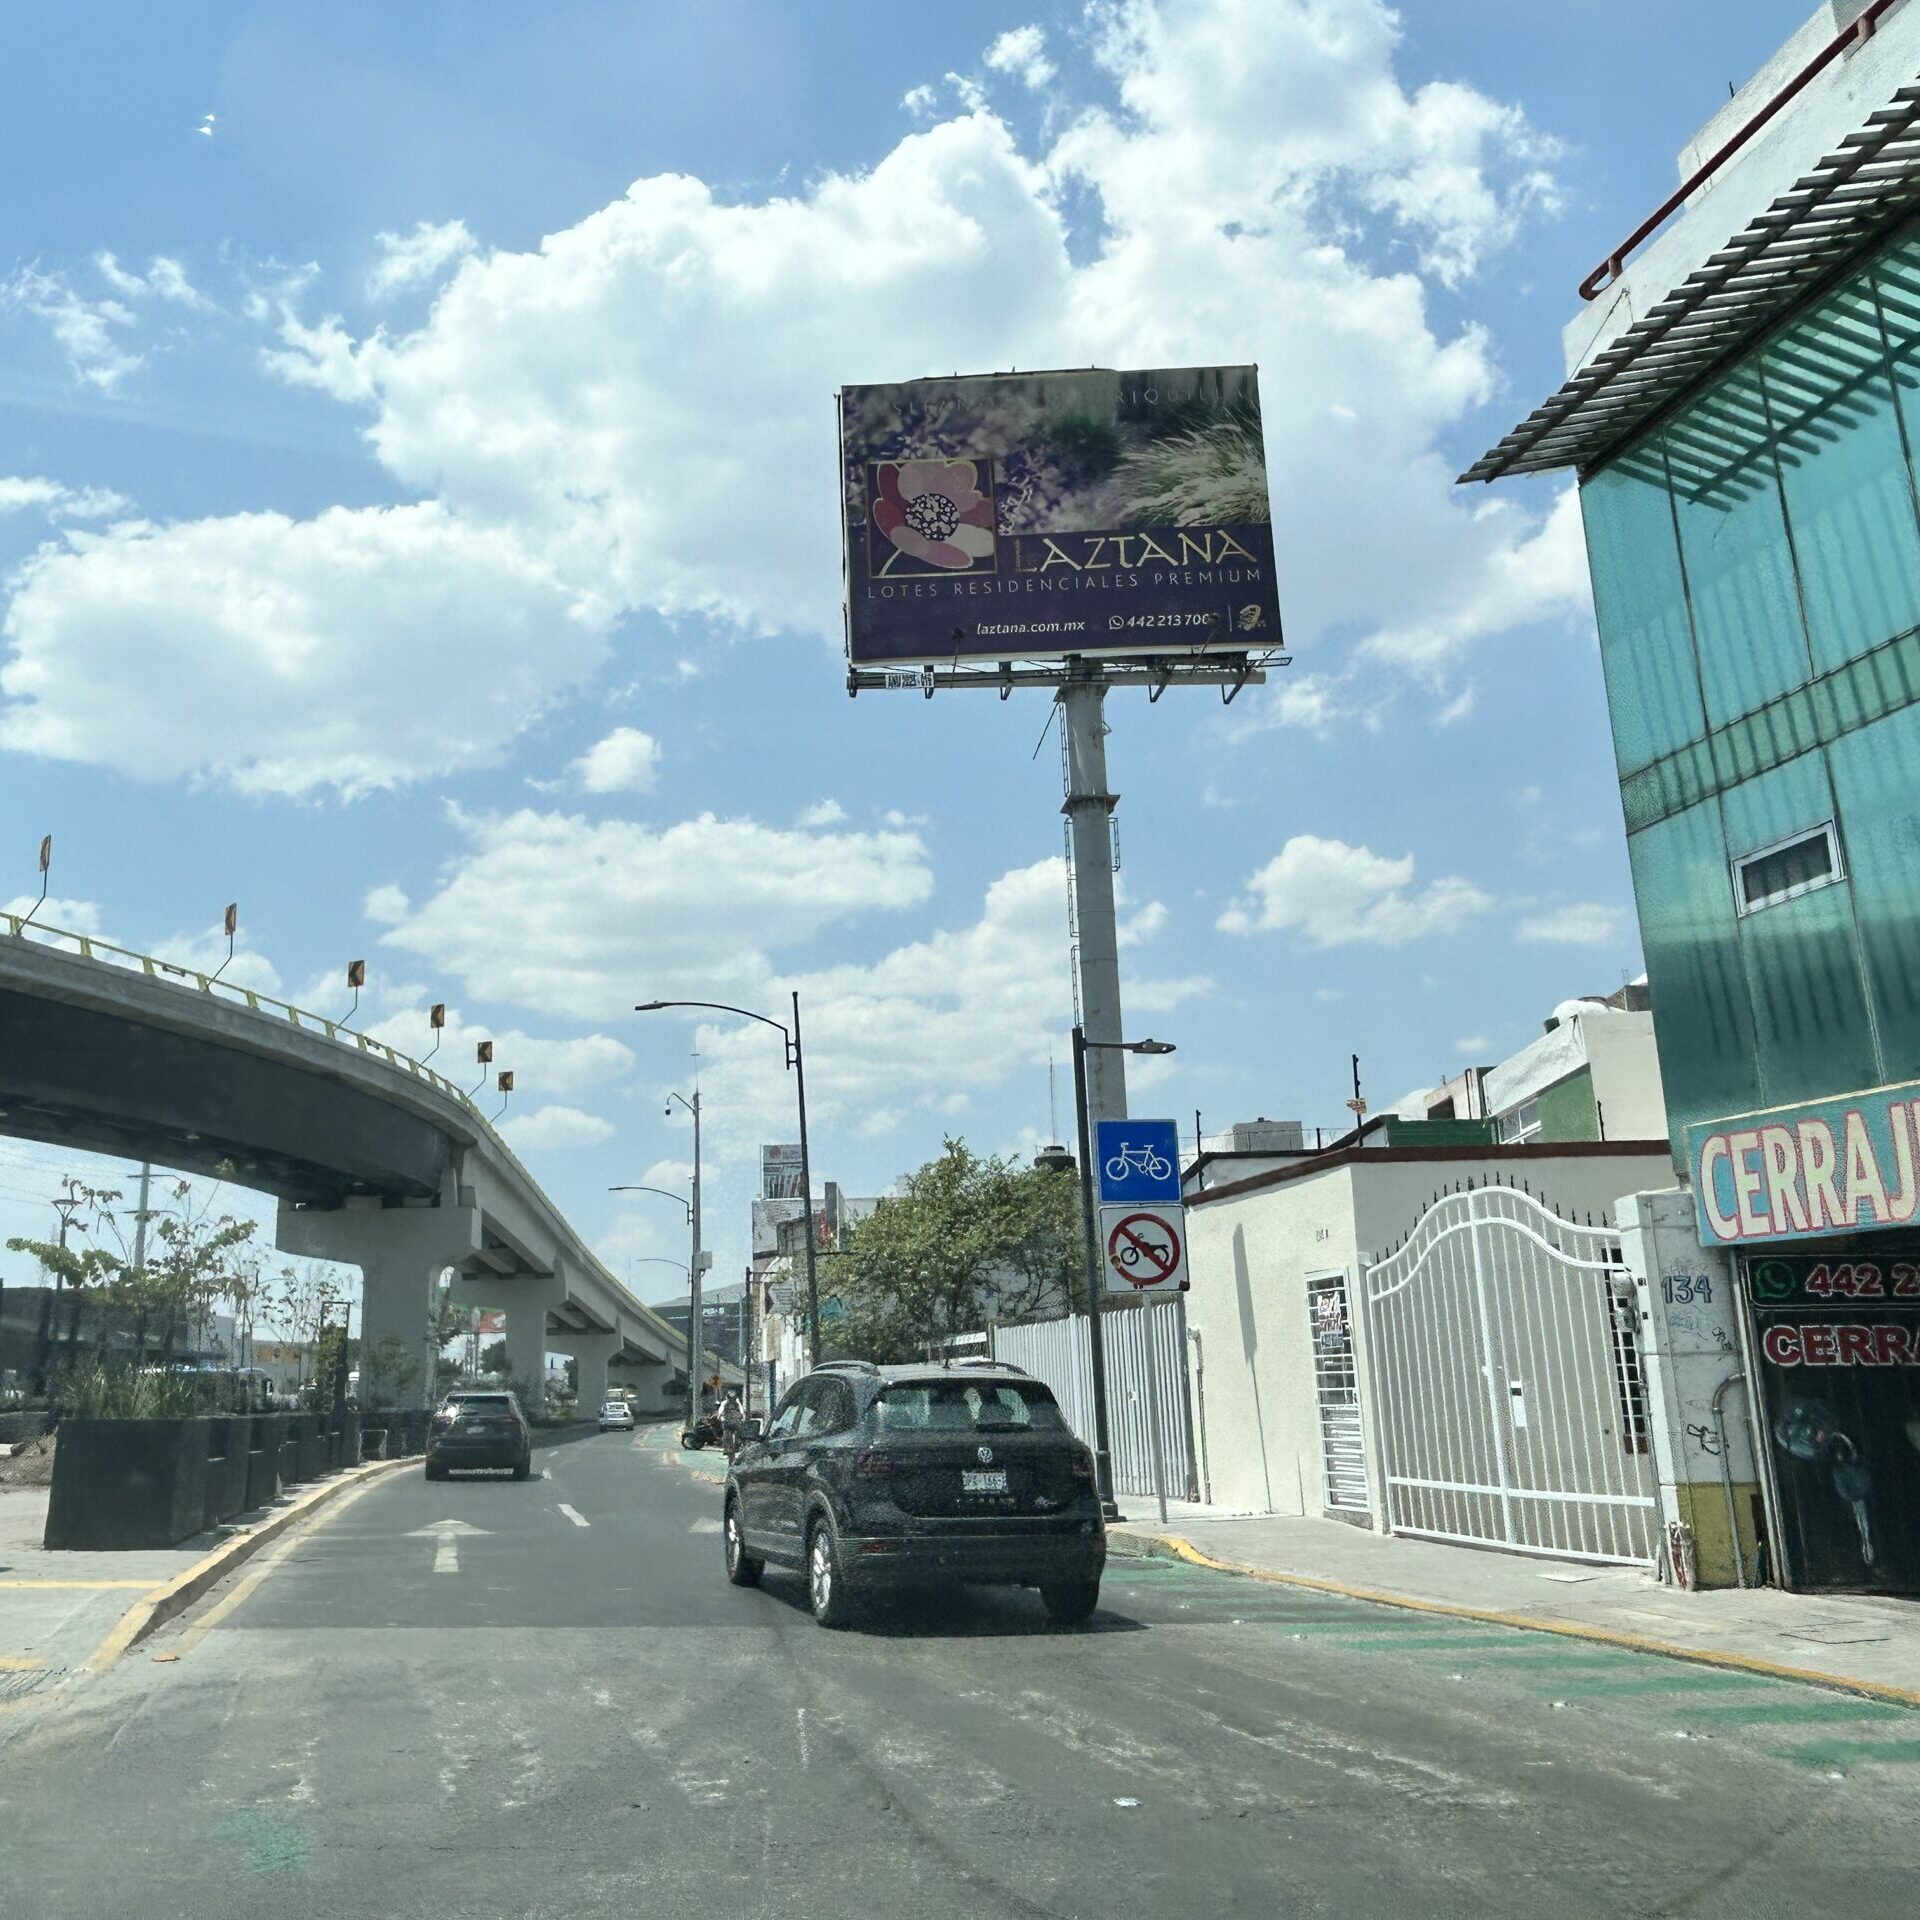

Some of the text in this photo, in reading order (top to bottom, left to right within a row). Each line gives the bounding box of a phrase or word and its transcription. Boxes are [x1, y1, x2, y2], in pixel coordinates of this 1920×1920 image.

[1015, 529, 1258, 573] LAZTANA
[868, 568, 1261, 599] LOTES RESIDENCIALES PREMIUM
[976, 619, 1086, 635] laztana.com.mx
[1700, 1097, 1920, 1240] CERRAJ
[1662, 1275, 1713, 1304] 134
[1805, 1262, 1920, 1297] 442 2
[1764, 1324, 1920, 1366] CERR
